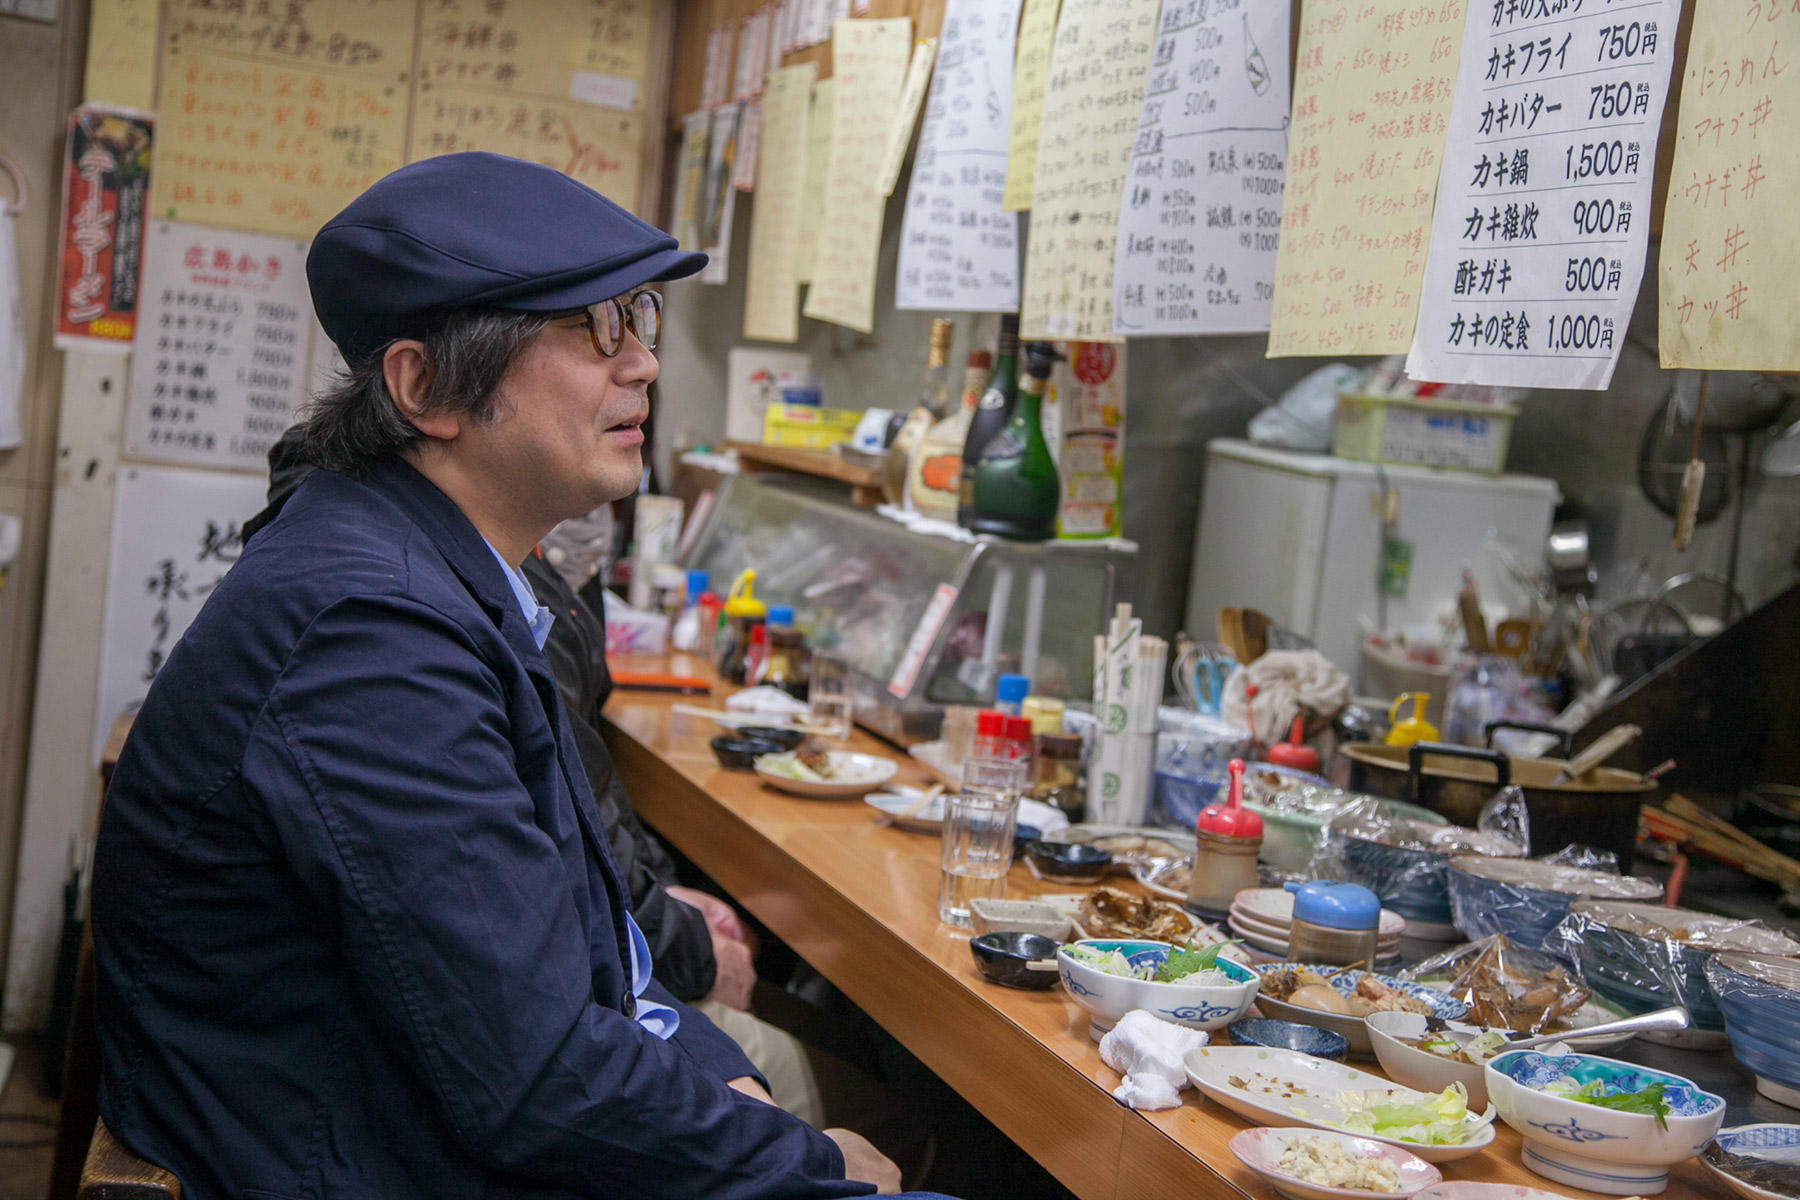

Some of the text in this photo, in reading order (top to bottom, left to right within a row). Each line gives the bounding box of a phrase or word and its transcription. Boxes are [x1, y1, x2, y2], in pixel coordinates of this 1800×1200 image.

[1485, 32, 1573, 82] カキフライ
[1598, 22, 1657, 62] 750円
[1478, 92, 1562, 135] カキバター
[1589, 81, 1649, 120] 750円
[1470, 148, 1529, 189] カキ鍋
[1566, 140, 1640, 183] 1,500円
[1462, 202, 1540, 241] カキ雑炊
[1573, 198, 1632, 235] 900円
[1454, 258, 1512, 296] 酢ガキ
[1566, 256, 1622, 292] 500円
[1447, 310, 1531, 350] カキの定食
[1547, 314, 1615, 353] 1,000円
